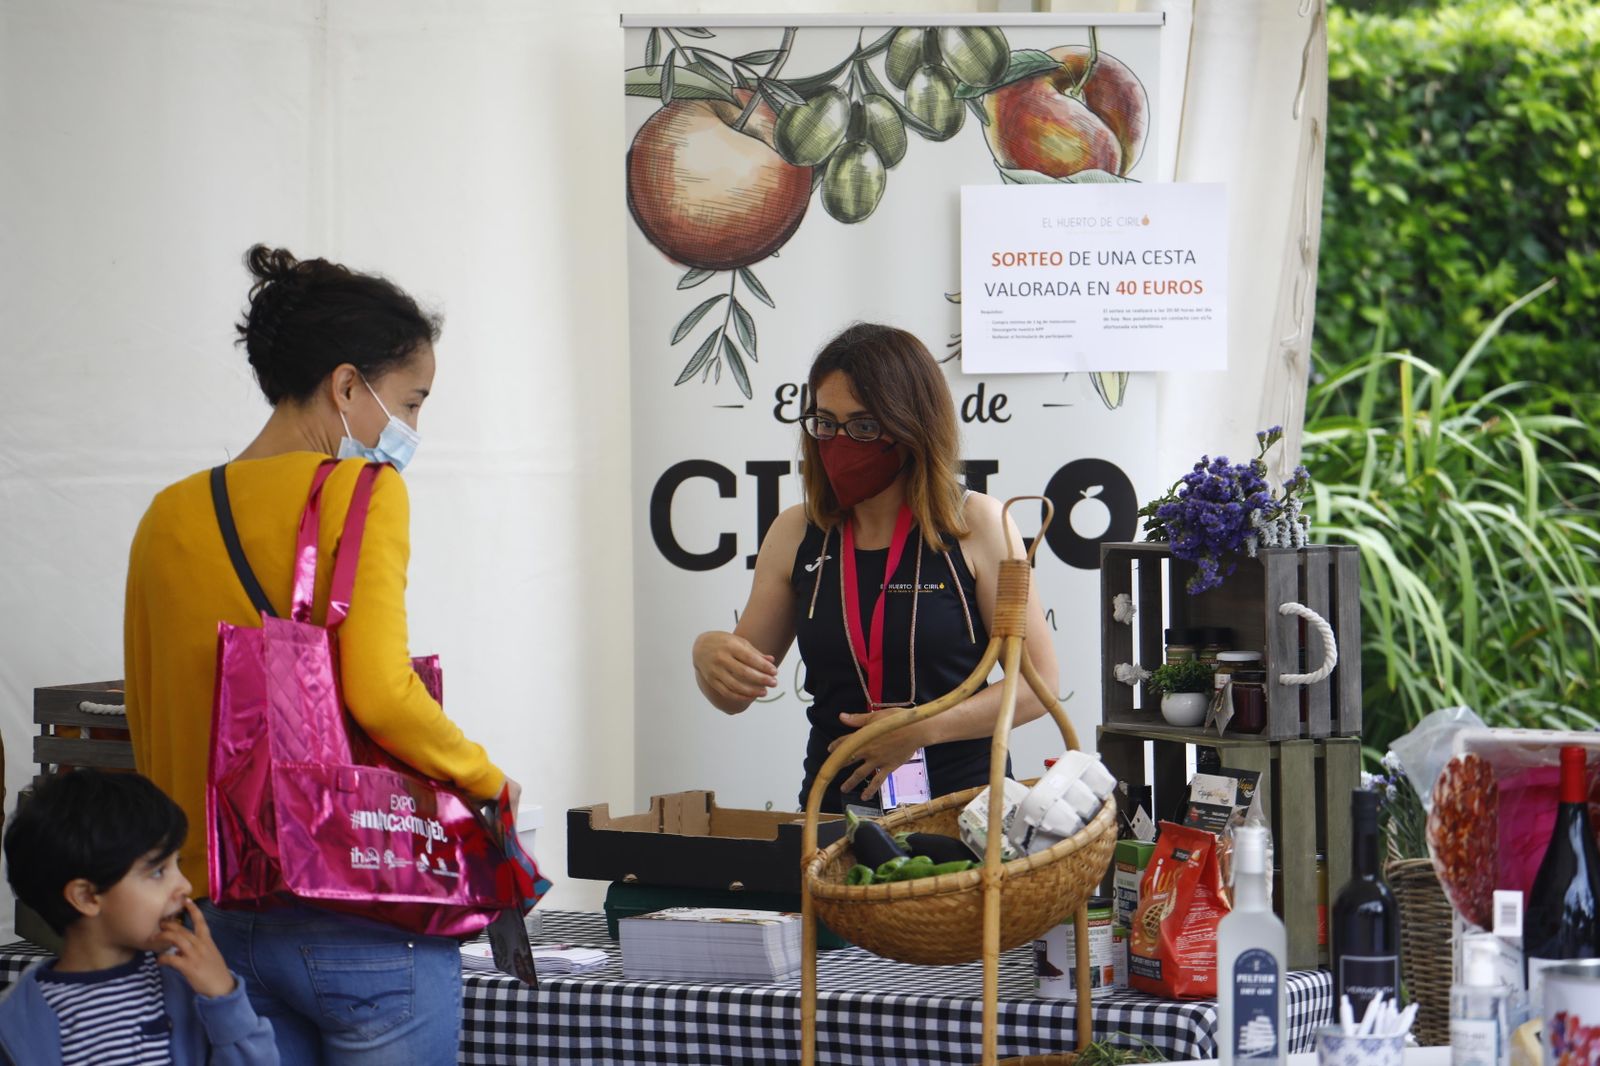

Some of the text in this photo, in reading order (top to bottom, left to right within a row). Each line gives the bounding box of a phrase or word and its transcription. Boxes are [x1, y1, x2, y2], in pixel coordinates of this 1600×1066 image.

[1057, 216, 1097, 229] HUERTO
[1100, 216, 1113, 228] DE
[991, 249, 1197, 267] SORTEO DE UNA CESTA
[984, 279, 1204, 297] VALORADA EN 40 EUROS
[961, 382, 1012, 424] de
[390, 794, 416, 812] EXPO
